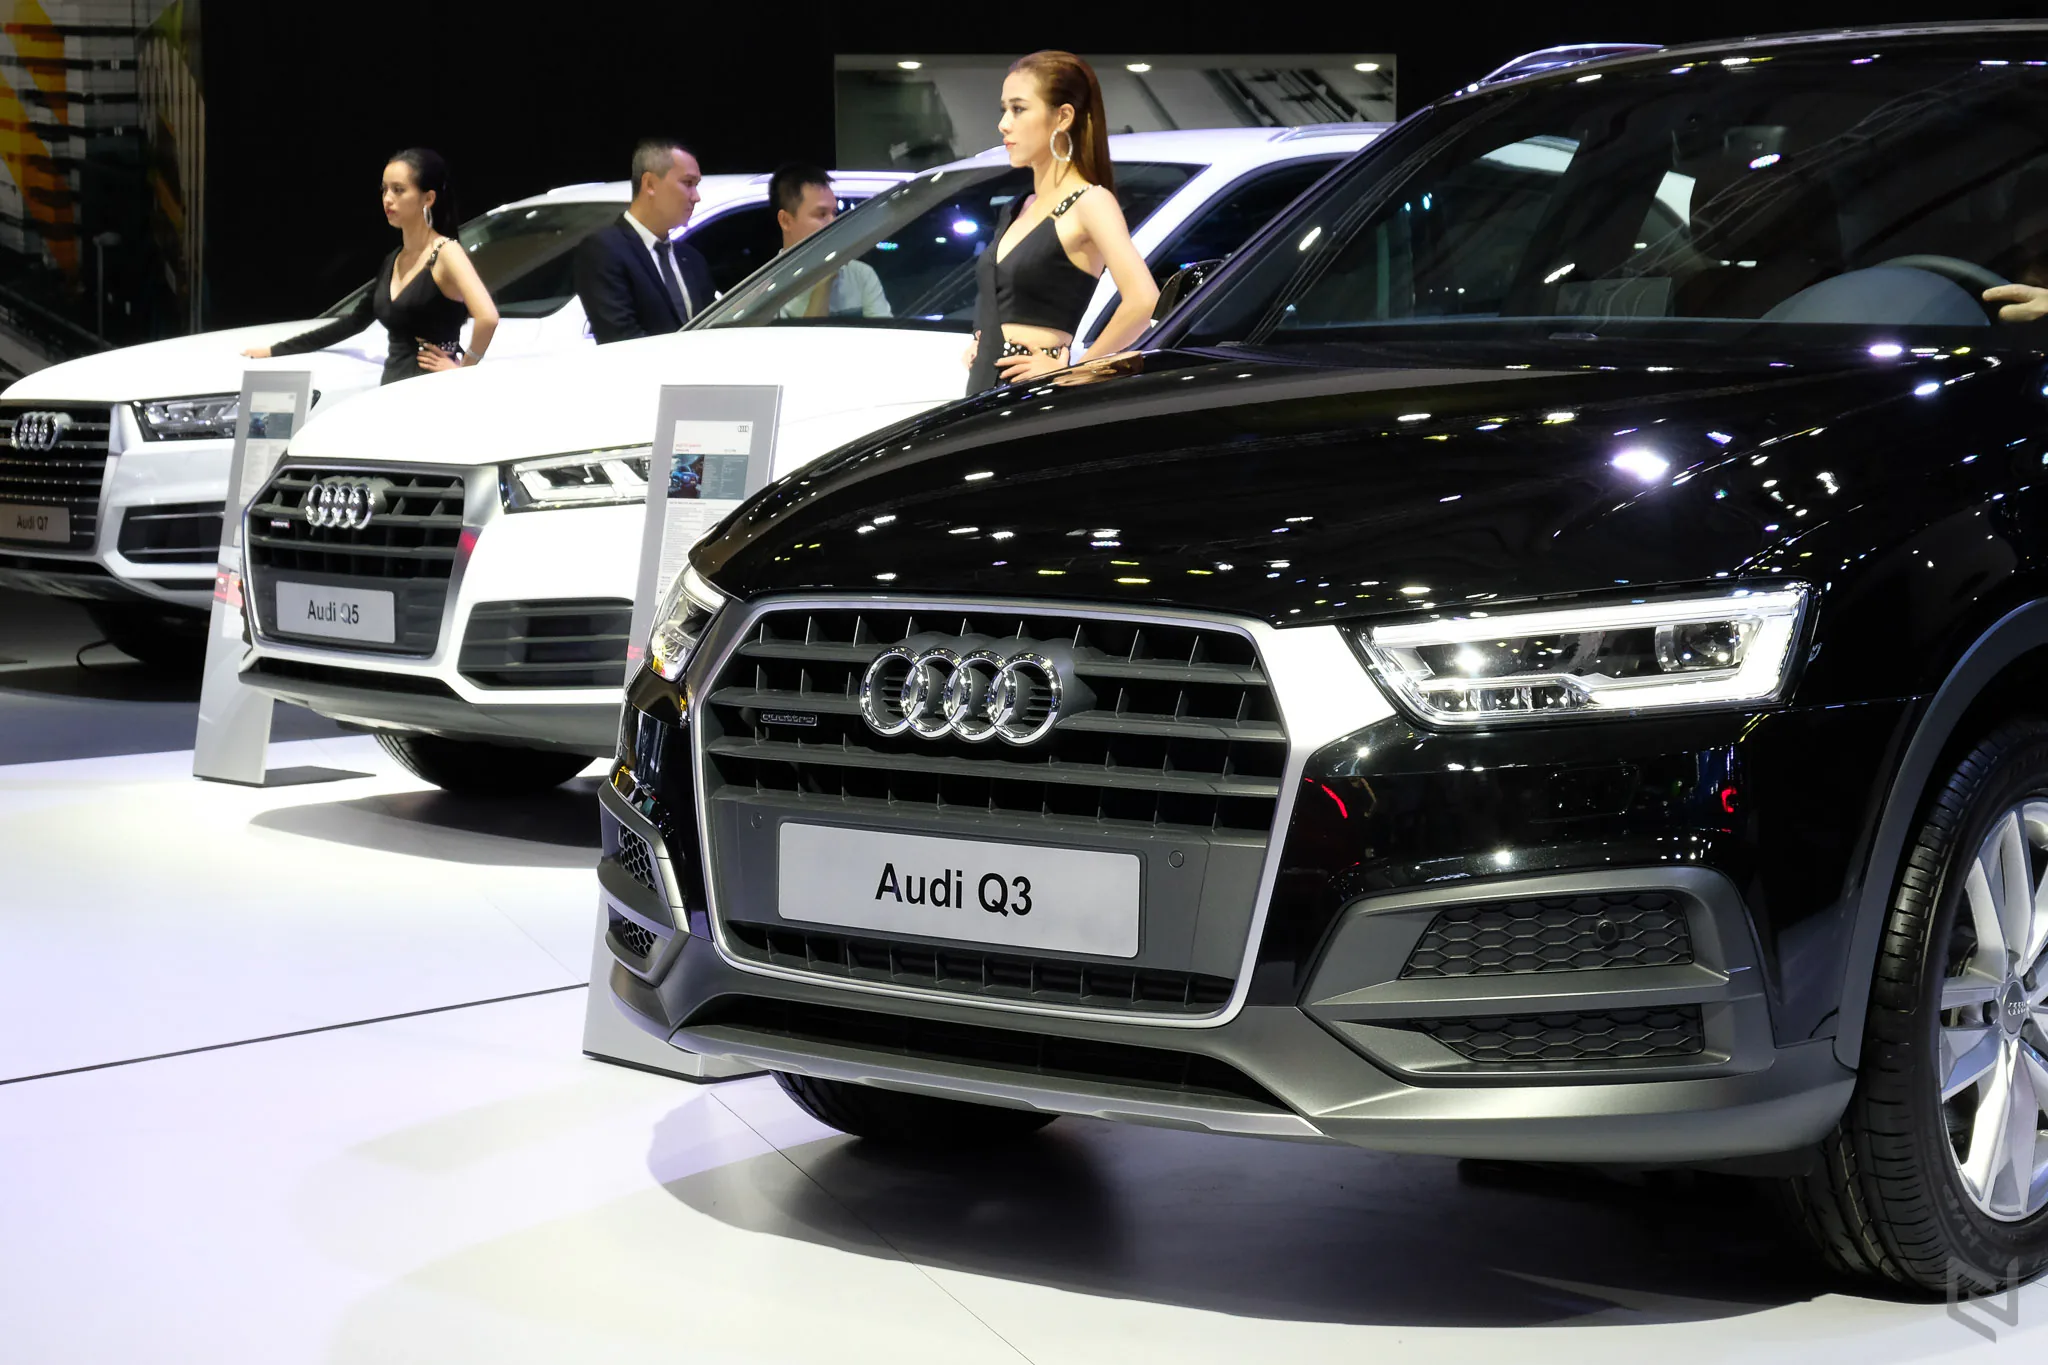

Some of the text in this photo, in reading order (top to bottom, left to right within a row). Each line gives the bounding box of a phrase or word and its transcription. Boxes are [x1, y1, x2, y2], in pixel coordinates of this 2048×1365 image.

[307, 599, 360, 625] Audi Q5
[875, 862, 1033, 917] Audi Q3
